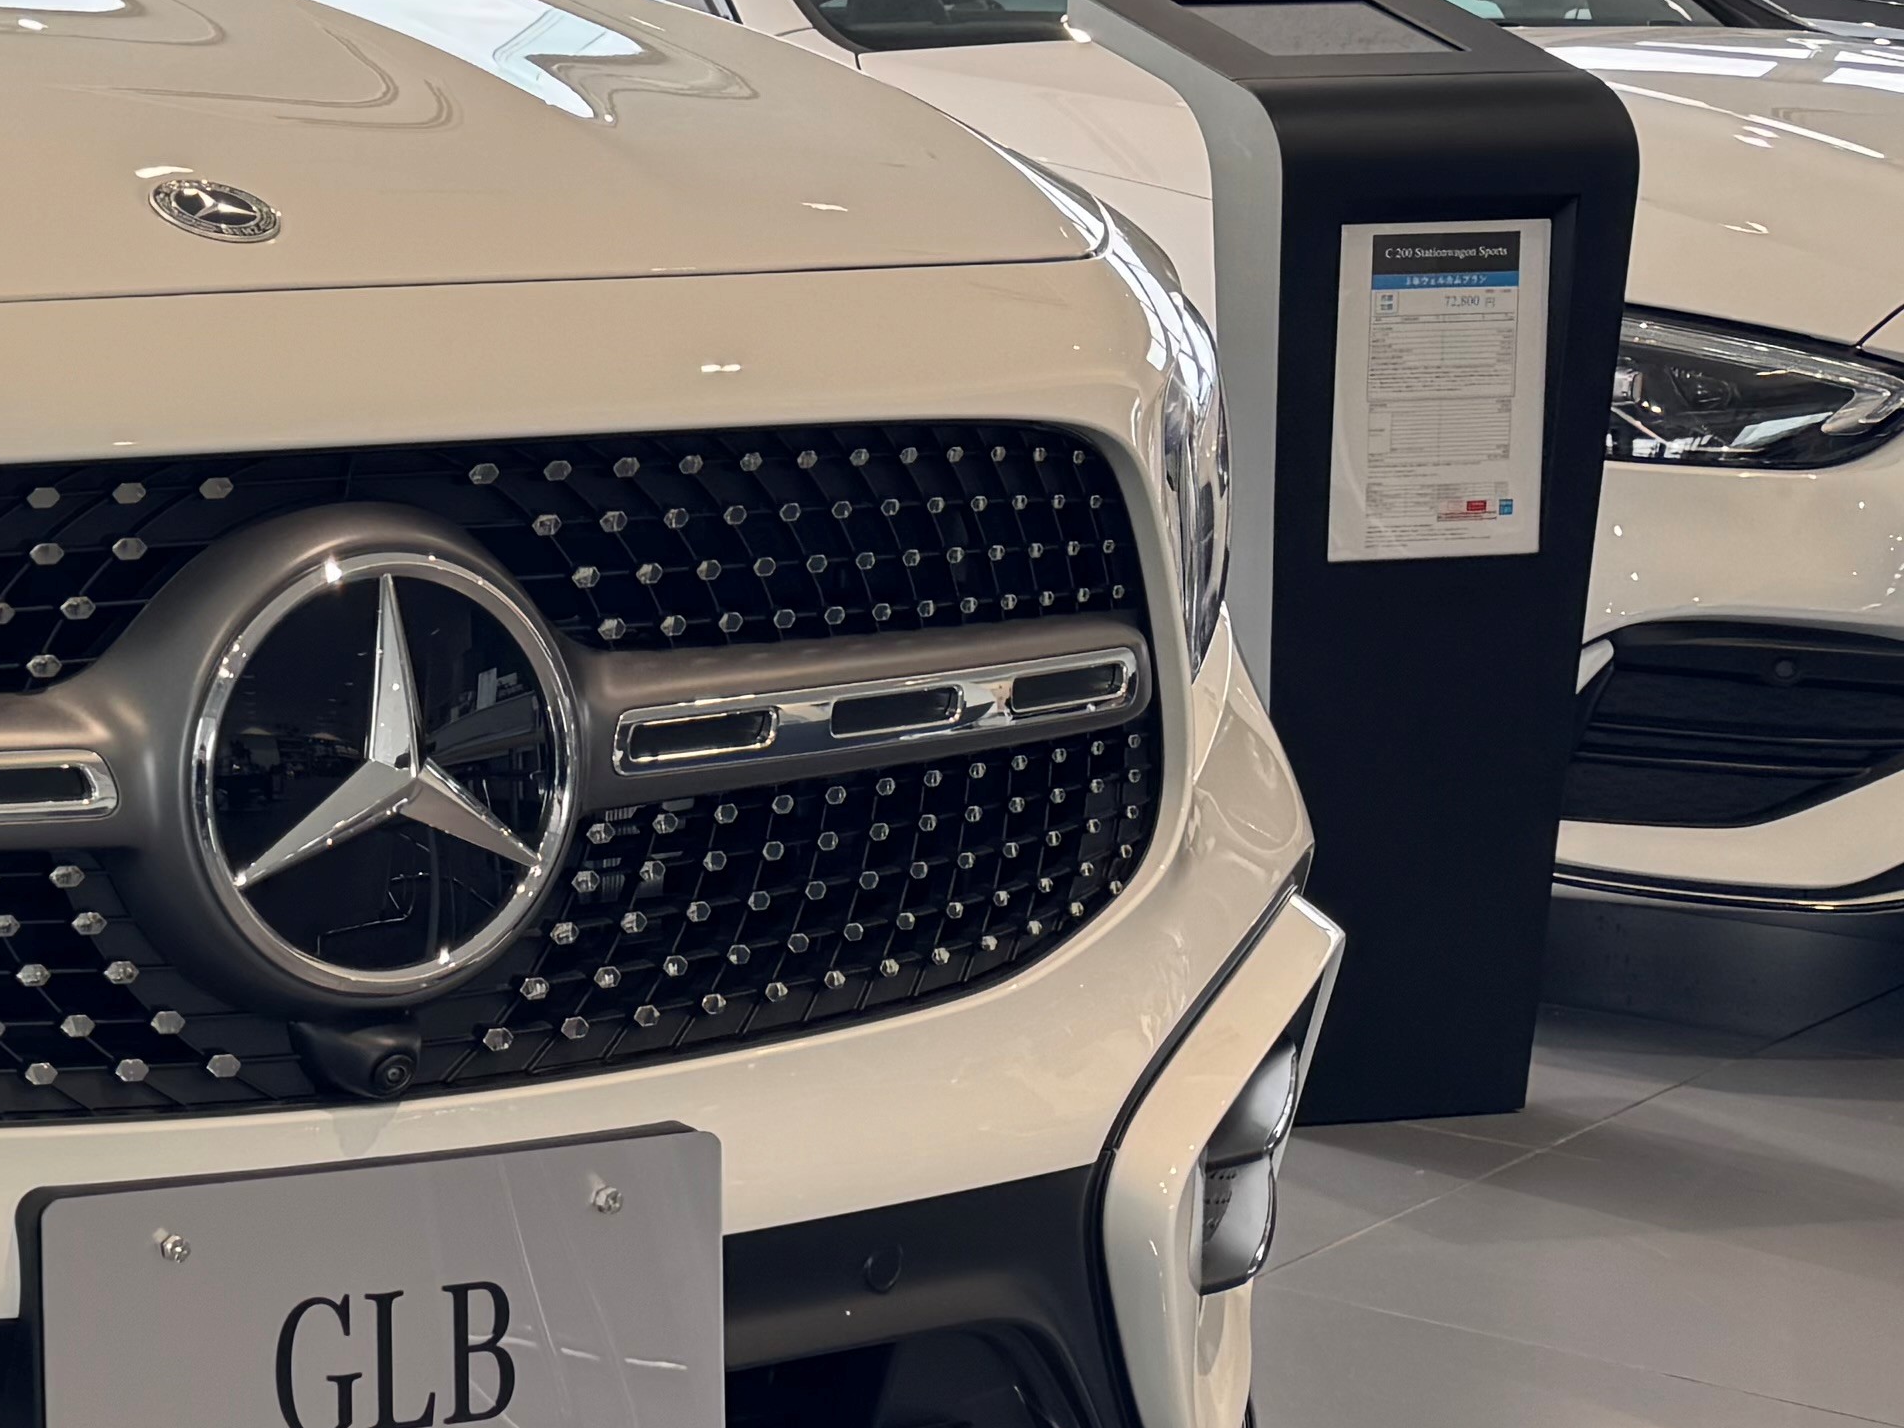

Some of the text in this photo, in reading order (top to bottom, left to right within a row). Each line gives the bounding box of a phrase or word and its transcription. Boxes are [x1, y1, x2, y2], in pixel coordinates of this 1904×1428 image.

[1384, 249, 1392, 259] C
[1395, 248, 1413, 259] 200
[1478, 245, 1508, 259] Sports
